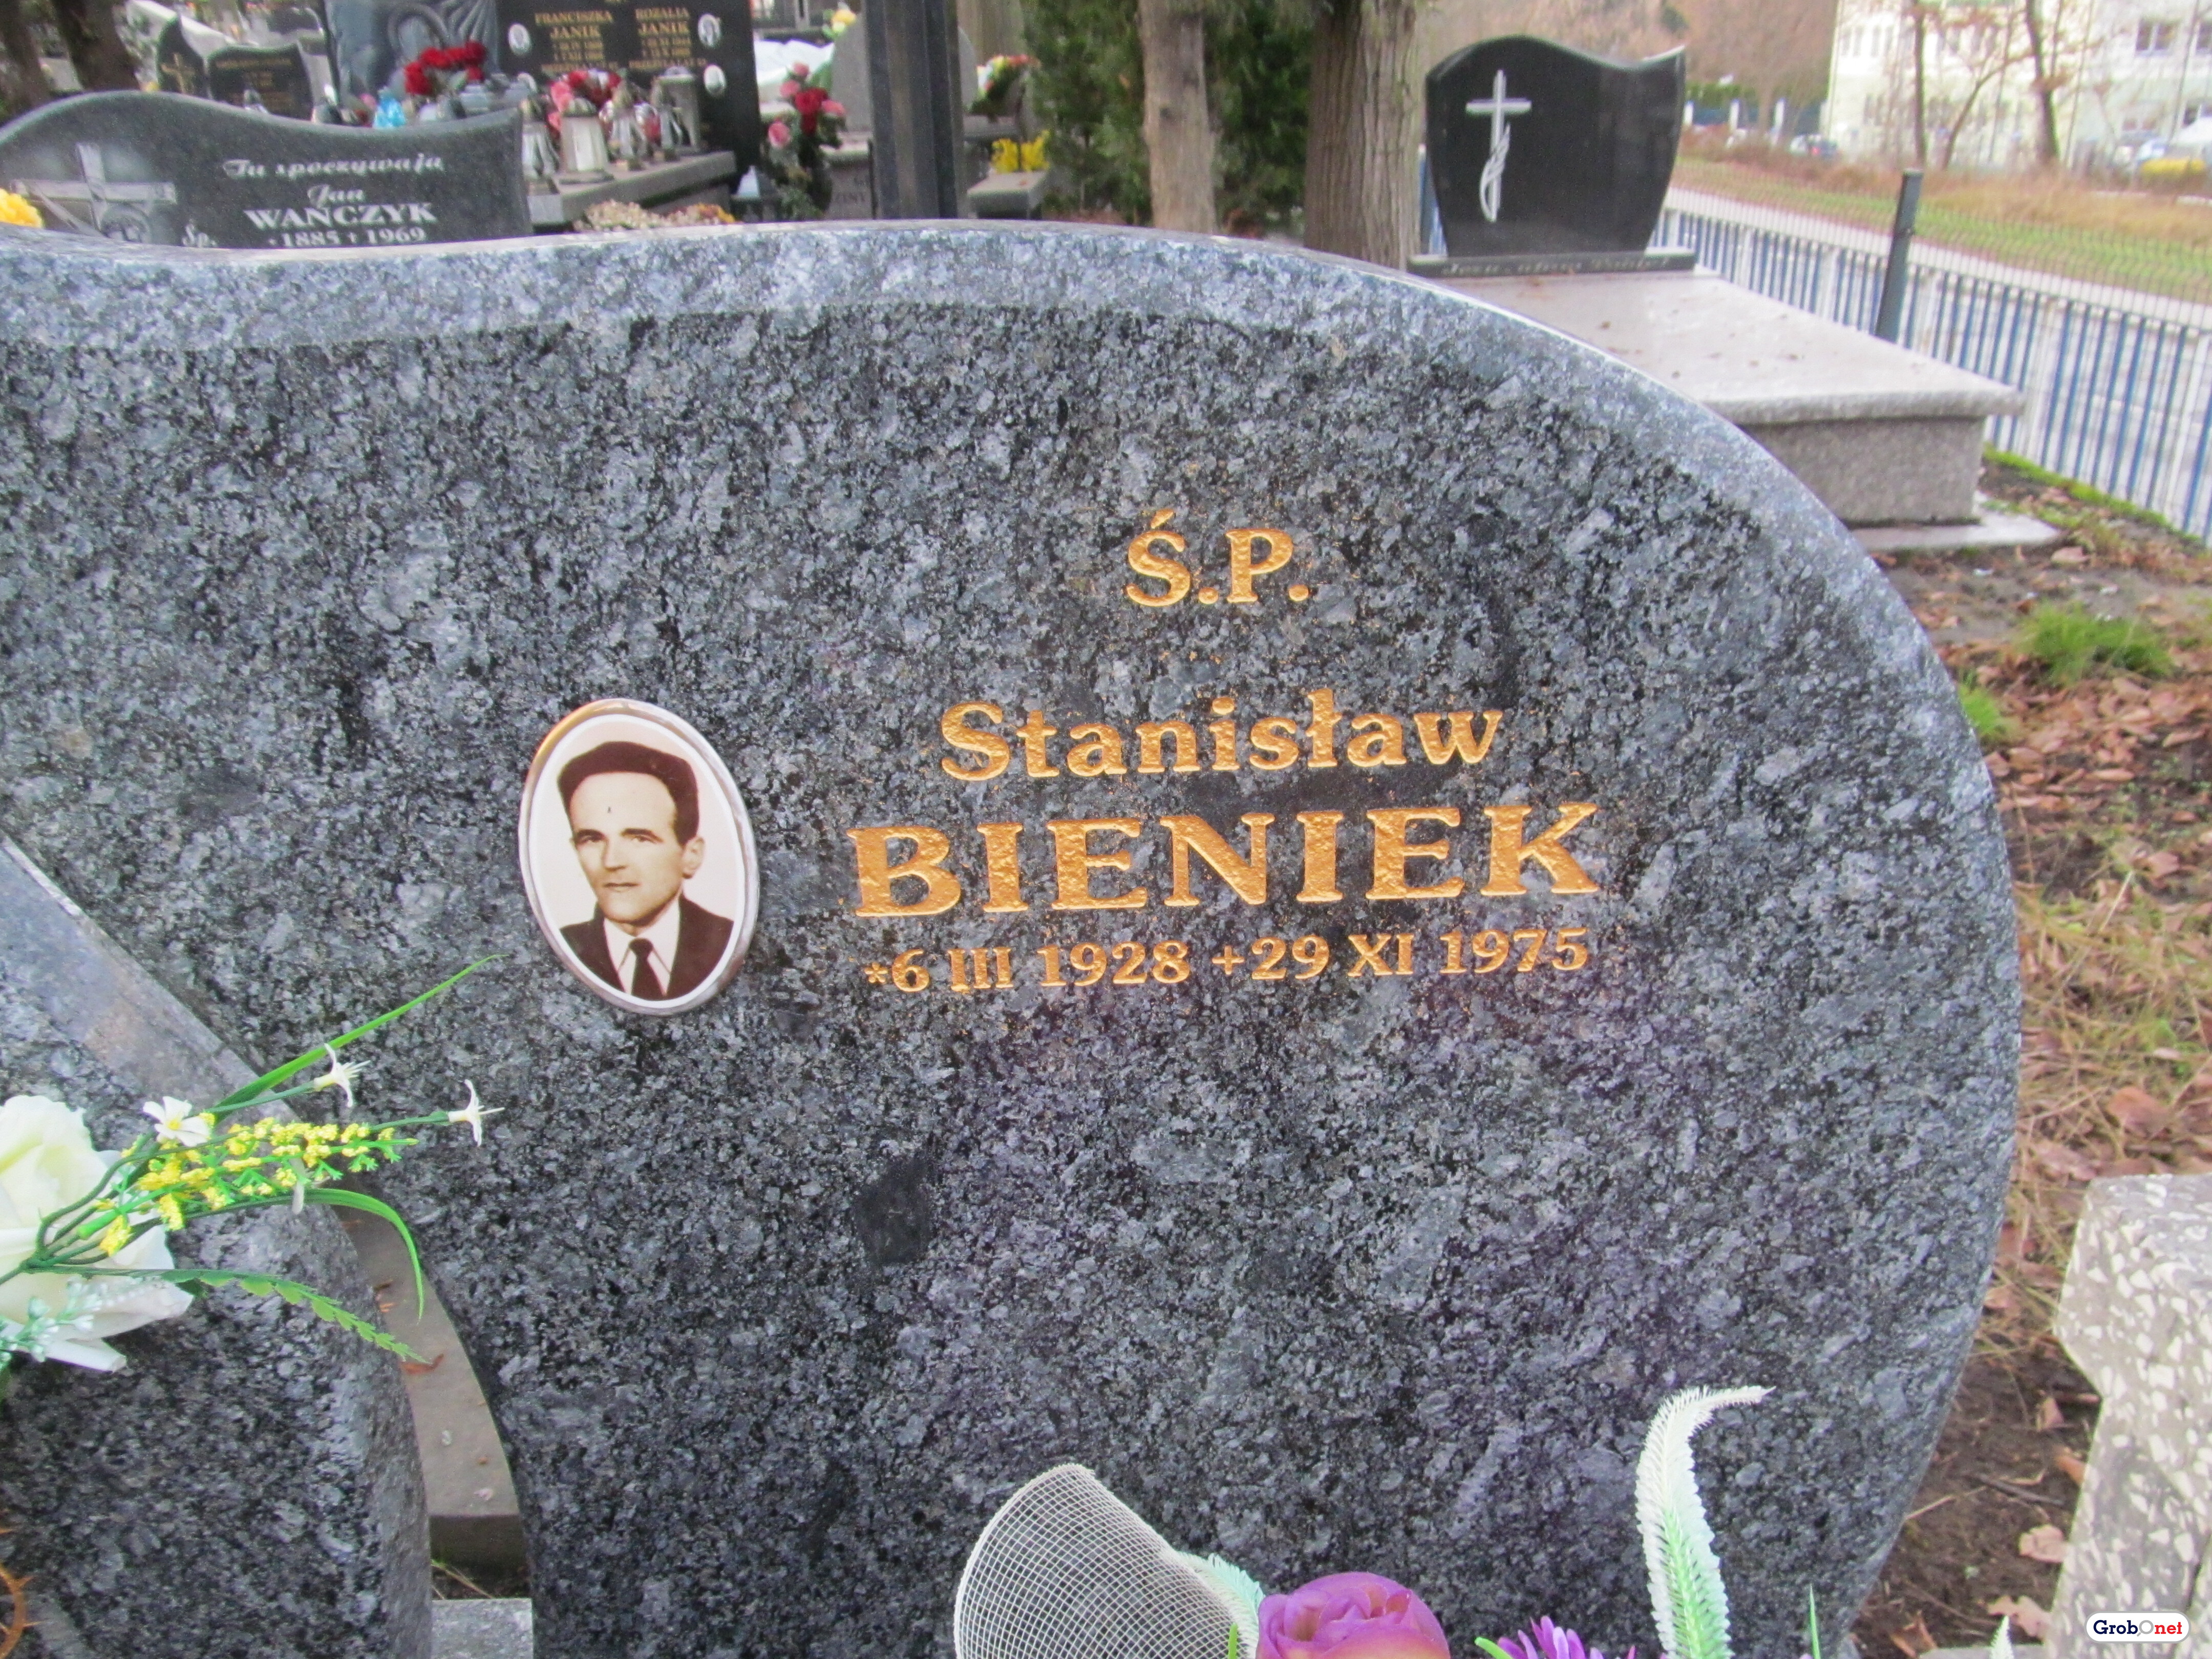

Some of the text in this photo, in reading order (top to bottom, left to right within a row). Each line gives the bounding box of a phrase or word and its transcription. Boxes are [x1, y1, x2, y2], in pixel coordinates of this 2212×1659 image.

[367, 226, 427, 244] 1969
[1126, 508, 1309, 607] Ś.P.
[941, 688, 1502, 780] Stanisław
[846, 802, 1600, 918] BIENIEK
[947, 946, 1014, 993] III
[1036, 940, 1191, 987] 1928
[1348, 933, 1414, 977] XI
[1439, 927, 1589, 974] 1975
